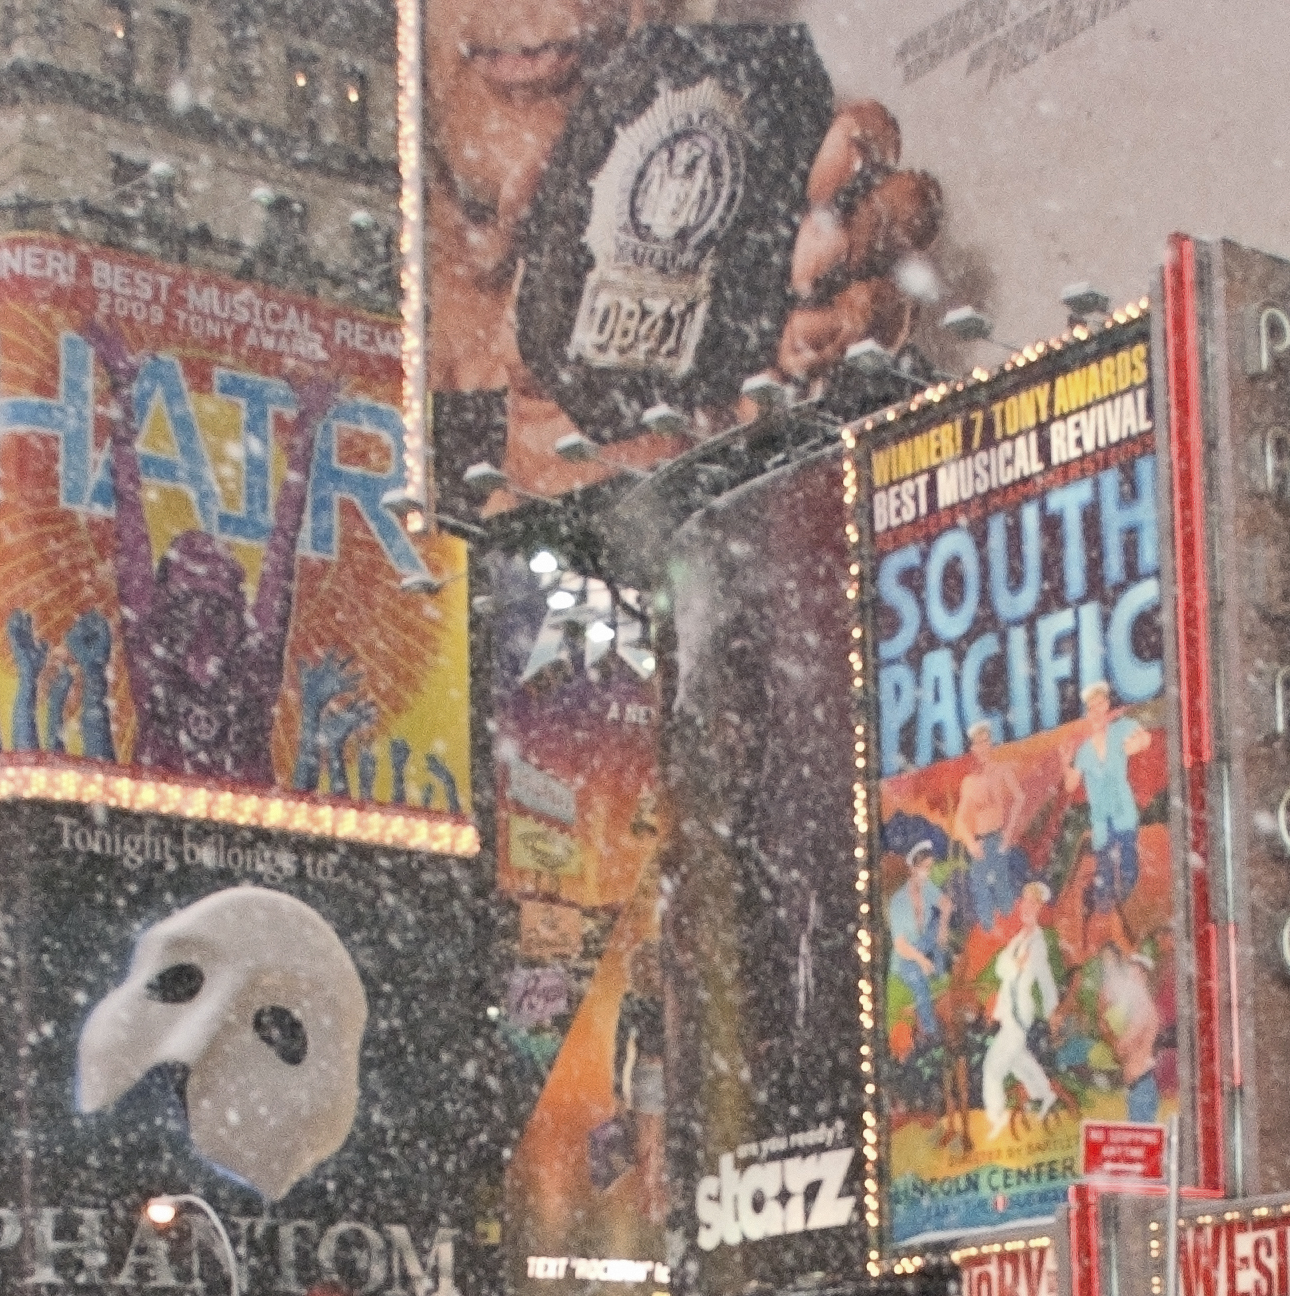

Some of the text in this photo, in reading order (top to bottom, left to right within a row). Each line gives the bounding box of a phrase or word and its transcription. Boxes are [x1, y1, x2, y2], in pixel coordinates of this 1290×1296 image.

[91, 260, 173, 301] BEST
[187, 283, 315, 337] MUSICAL
[175, 308, 235, 341] TONY
[871, 344, 1149, 487] WINNER! 7 TONY AWARDS
[873, 473, 929, 533] BEST
[936, 429, 1045, 509] MUSICAL
[1050, 387, 1153, 466] REVIVAL
[875, 455, 1158, 659] SOUTH
[879, 577, 1165, 775] PACIFIC
[55, 813, 173, 870] Tonight
[695, 1147, 857, 1251] starz
[986, 1156, 1077, 1192] CENTER
